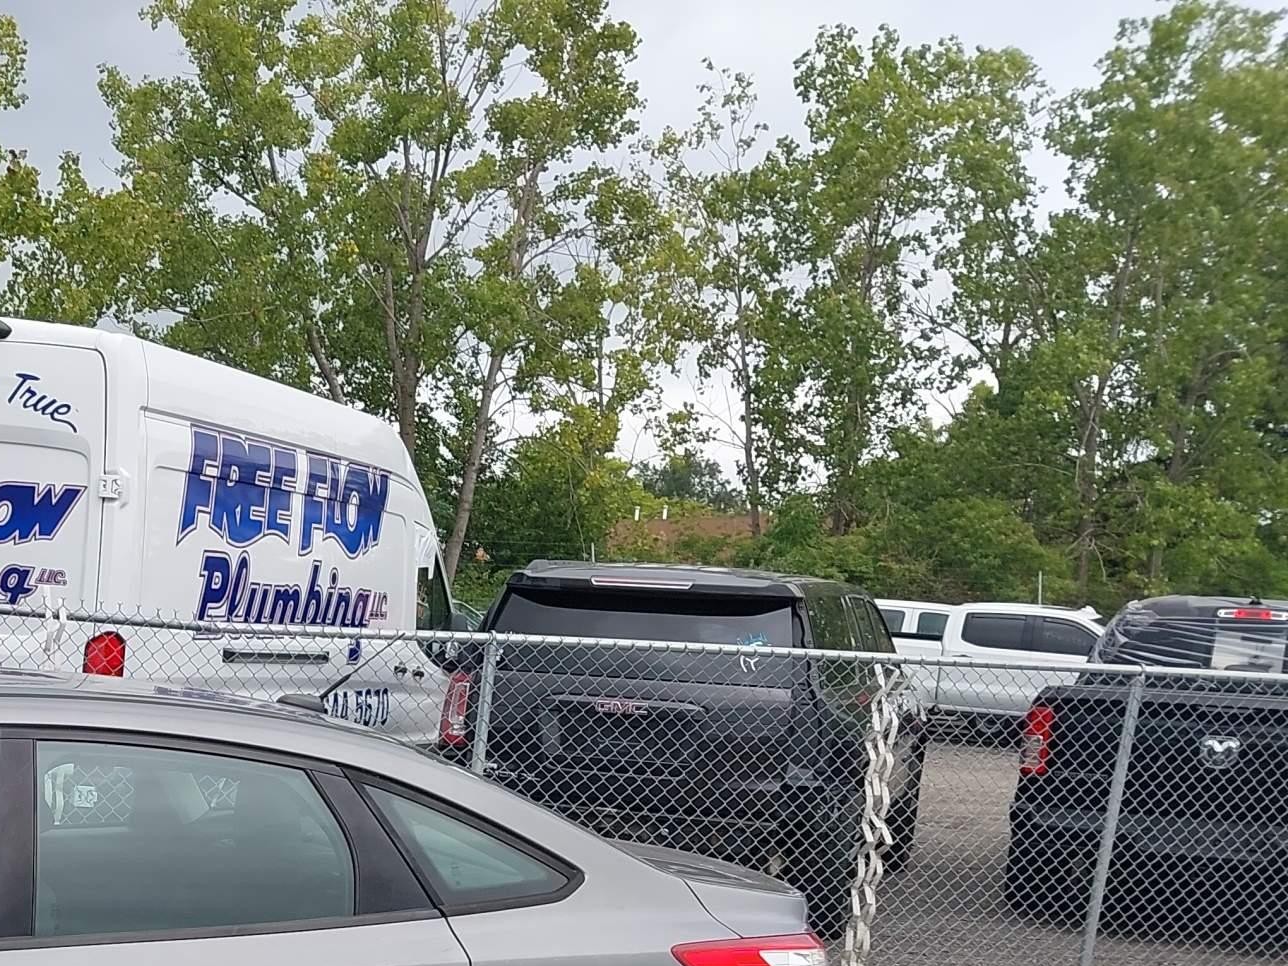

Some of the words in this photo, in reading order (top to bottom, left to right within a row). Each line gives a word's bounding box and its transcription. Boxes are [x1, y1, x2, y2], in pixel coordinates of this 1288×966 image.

[8, 372, 78, 433] True
[176, 424, 298, 548] FREE
[298, 449, 392, 560] FLOW
[353, 687, 390, 727] 5670
[595, 699, 649, 716] GMC
